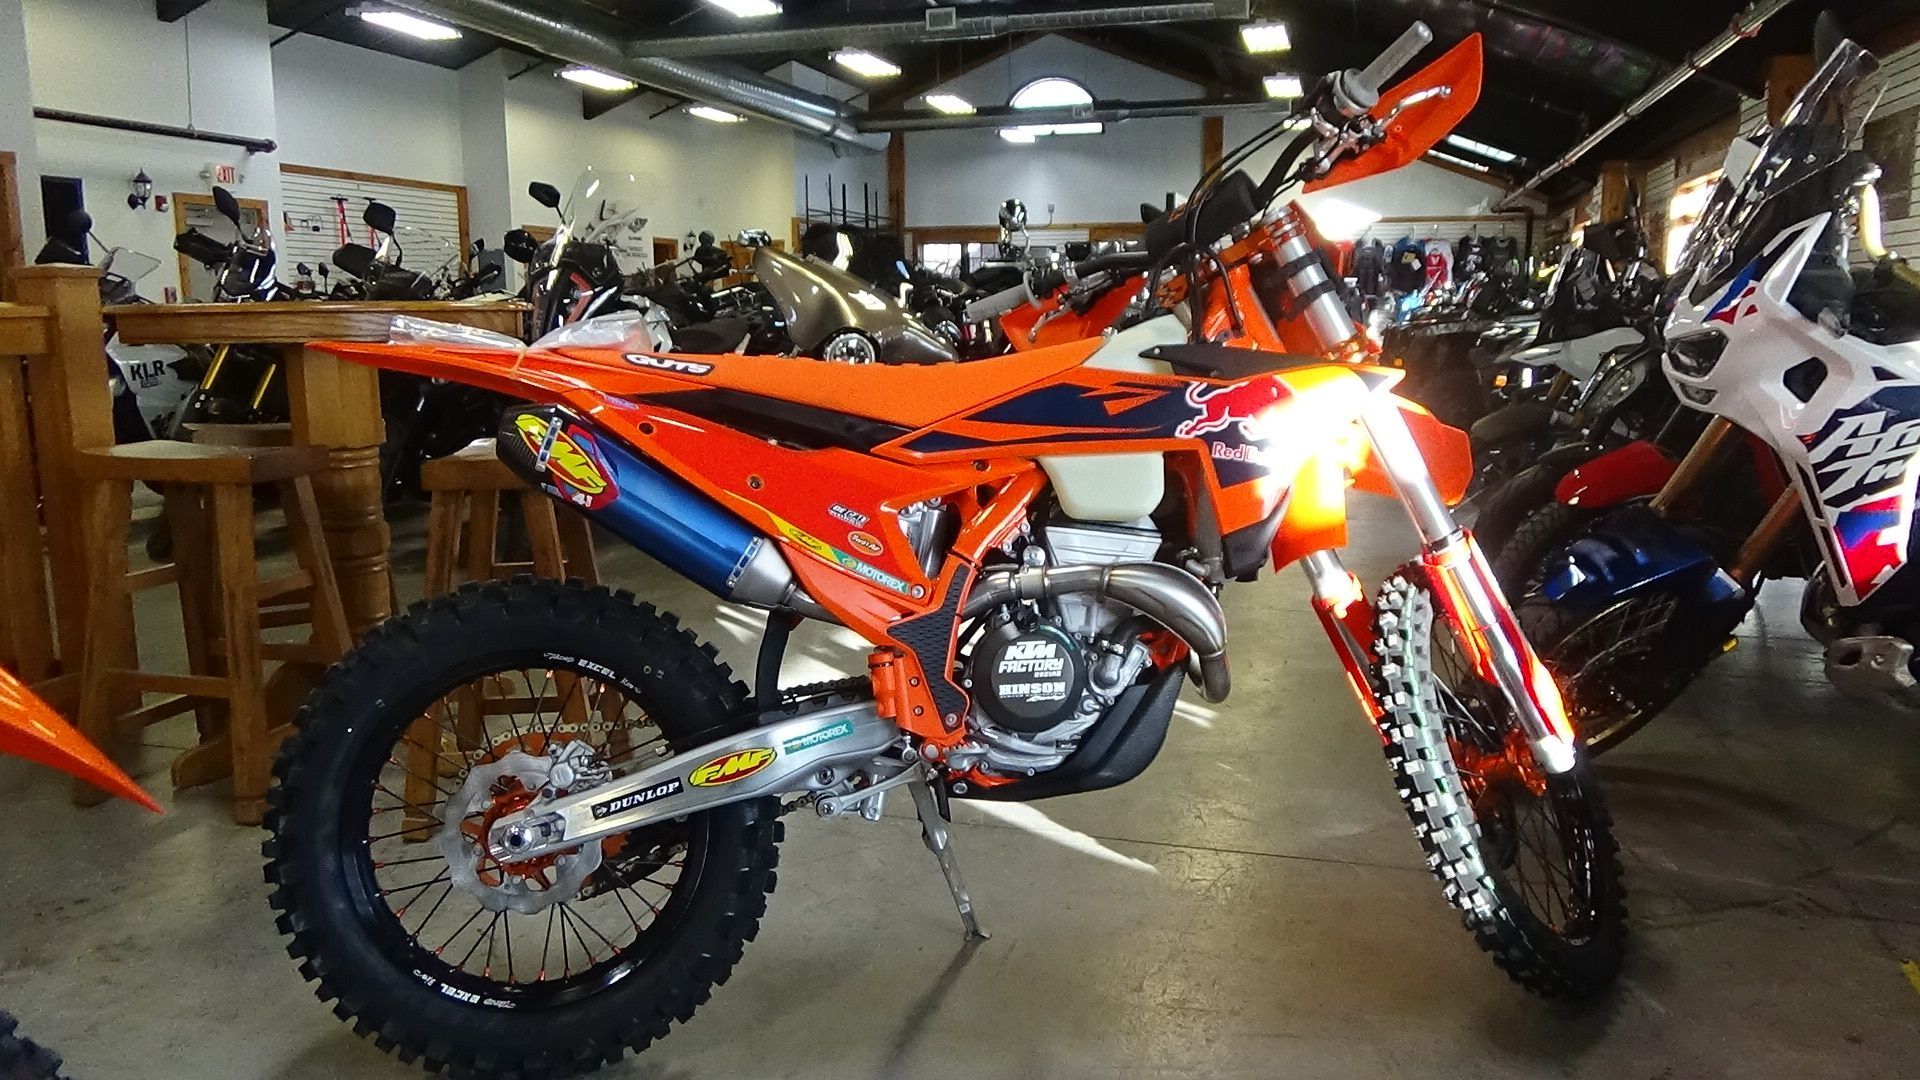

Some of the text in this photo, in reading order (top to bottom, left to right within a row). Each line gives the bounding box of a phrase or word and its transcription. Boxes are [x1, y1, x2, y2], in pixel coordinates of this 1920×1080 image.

[130, 360, 166, 381] KLR
[625, 354, 712, 374] GUTS
[855, 562, 907, 593] MOTOREX
[1004, 641, 1057, 660] KTM
[578, 658, 616, 680] EXCEL
[999, 658, 1064, 674] FACTORY
[693, 748, 775, 787] FMF
[608, 780, 681, 813] DUNLOP
